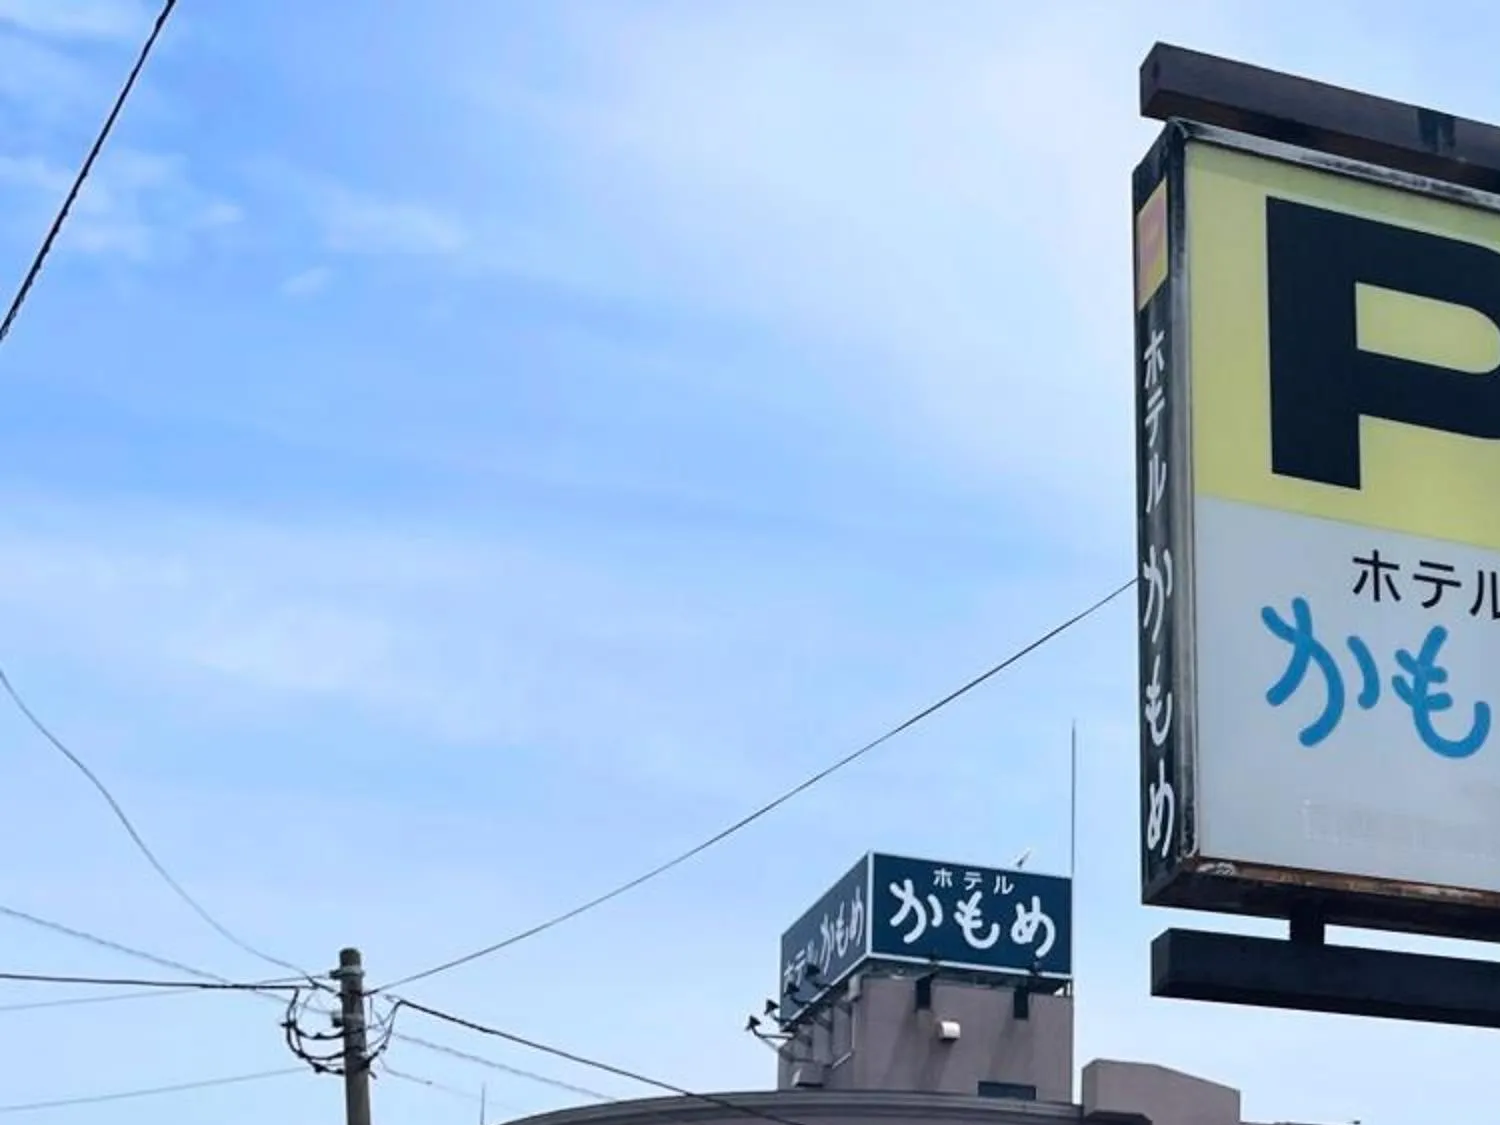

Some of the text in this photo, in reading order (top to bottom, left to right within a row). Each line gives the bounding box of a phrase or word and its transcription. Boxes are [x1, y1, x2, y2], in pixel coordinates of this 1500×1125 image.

[1143, 329, 1175, 857] ホテル かもめ
[889, 878, 1056, 958] かもめ
[933, 867, 1015, 895] ホテル
[820, 885, 864, 976] かもめ
